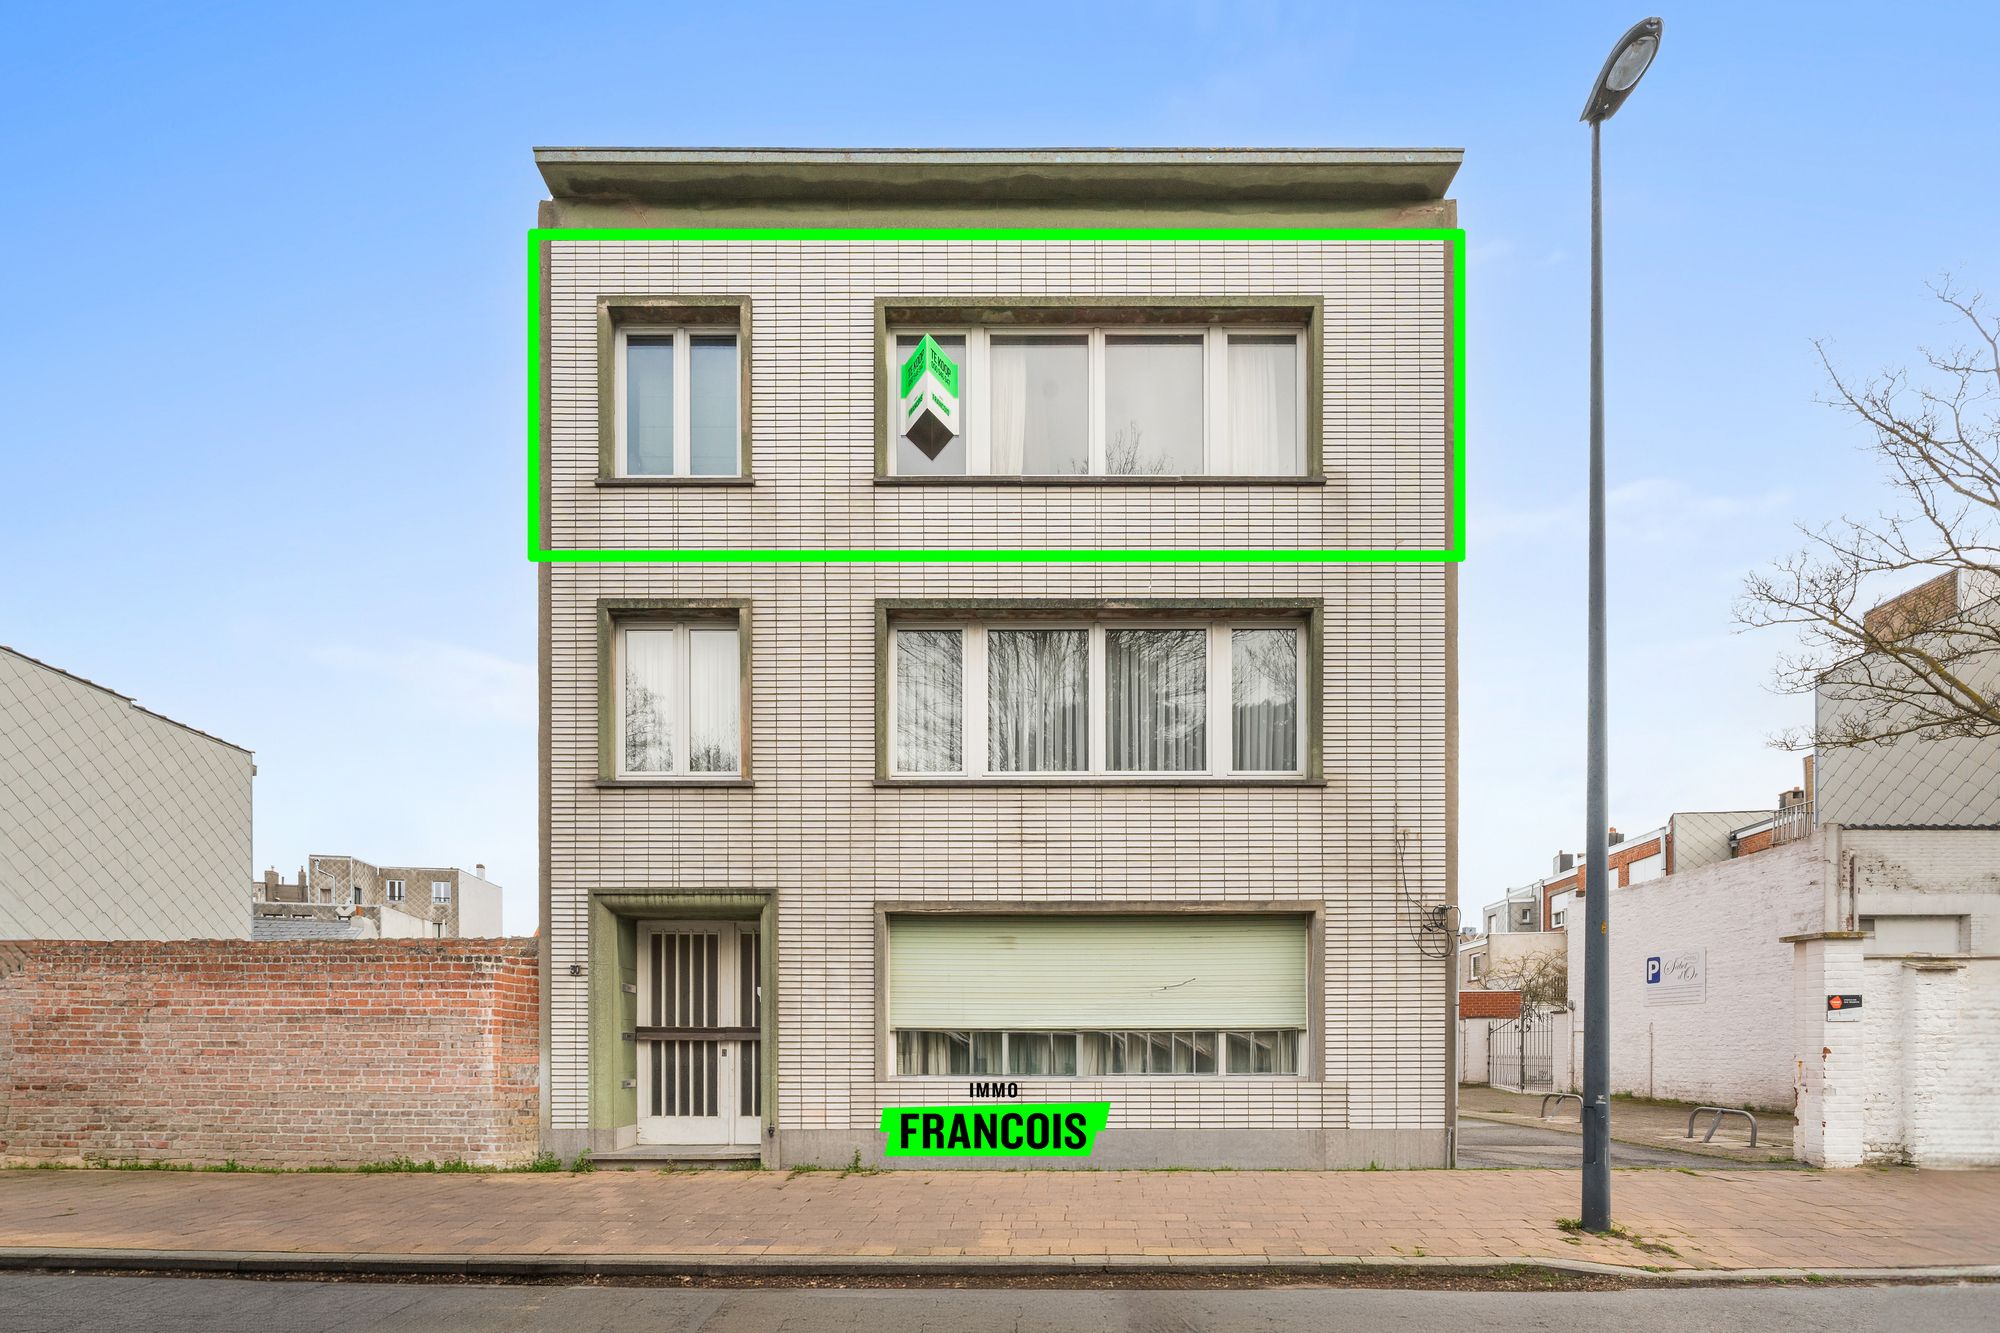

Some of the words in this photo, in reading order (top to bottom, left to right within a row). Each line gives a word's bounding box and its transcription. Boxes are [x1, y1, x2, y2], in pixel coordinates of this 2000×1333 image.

[930, 348, 937, 364] TE
[937, 356, 951, 377] KOOP
[1648, 960, 1659, 981] P
